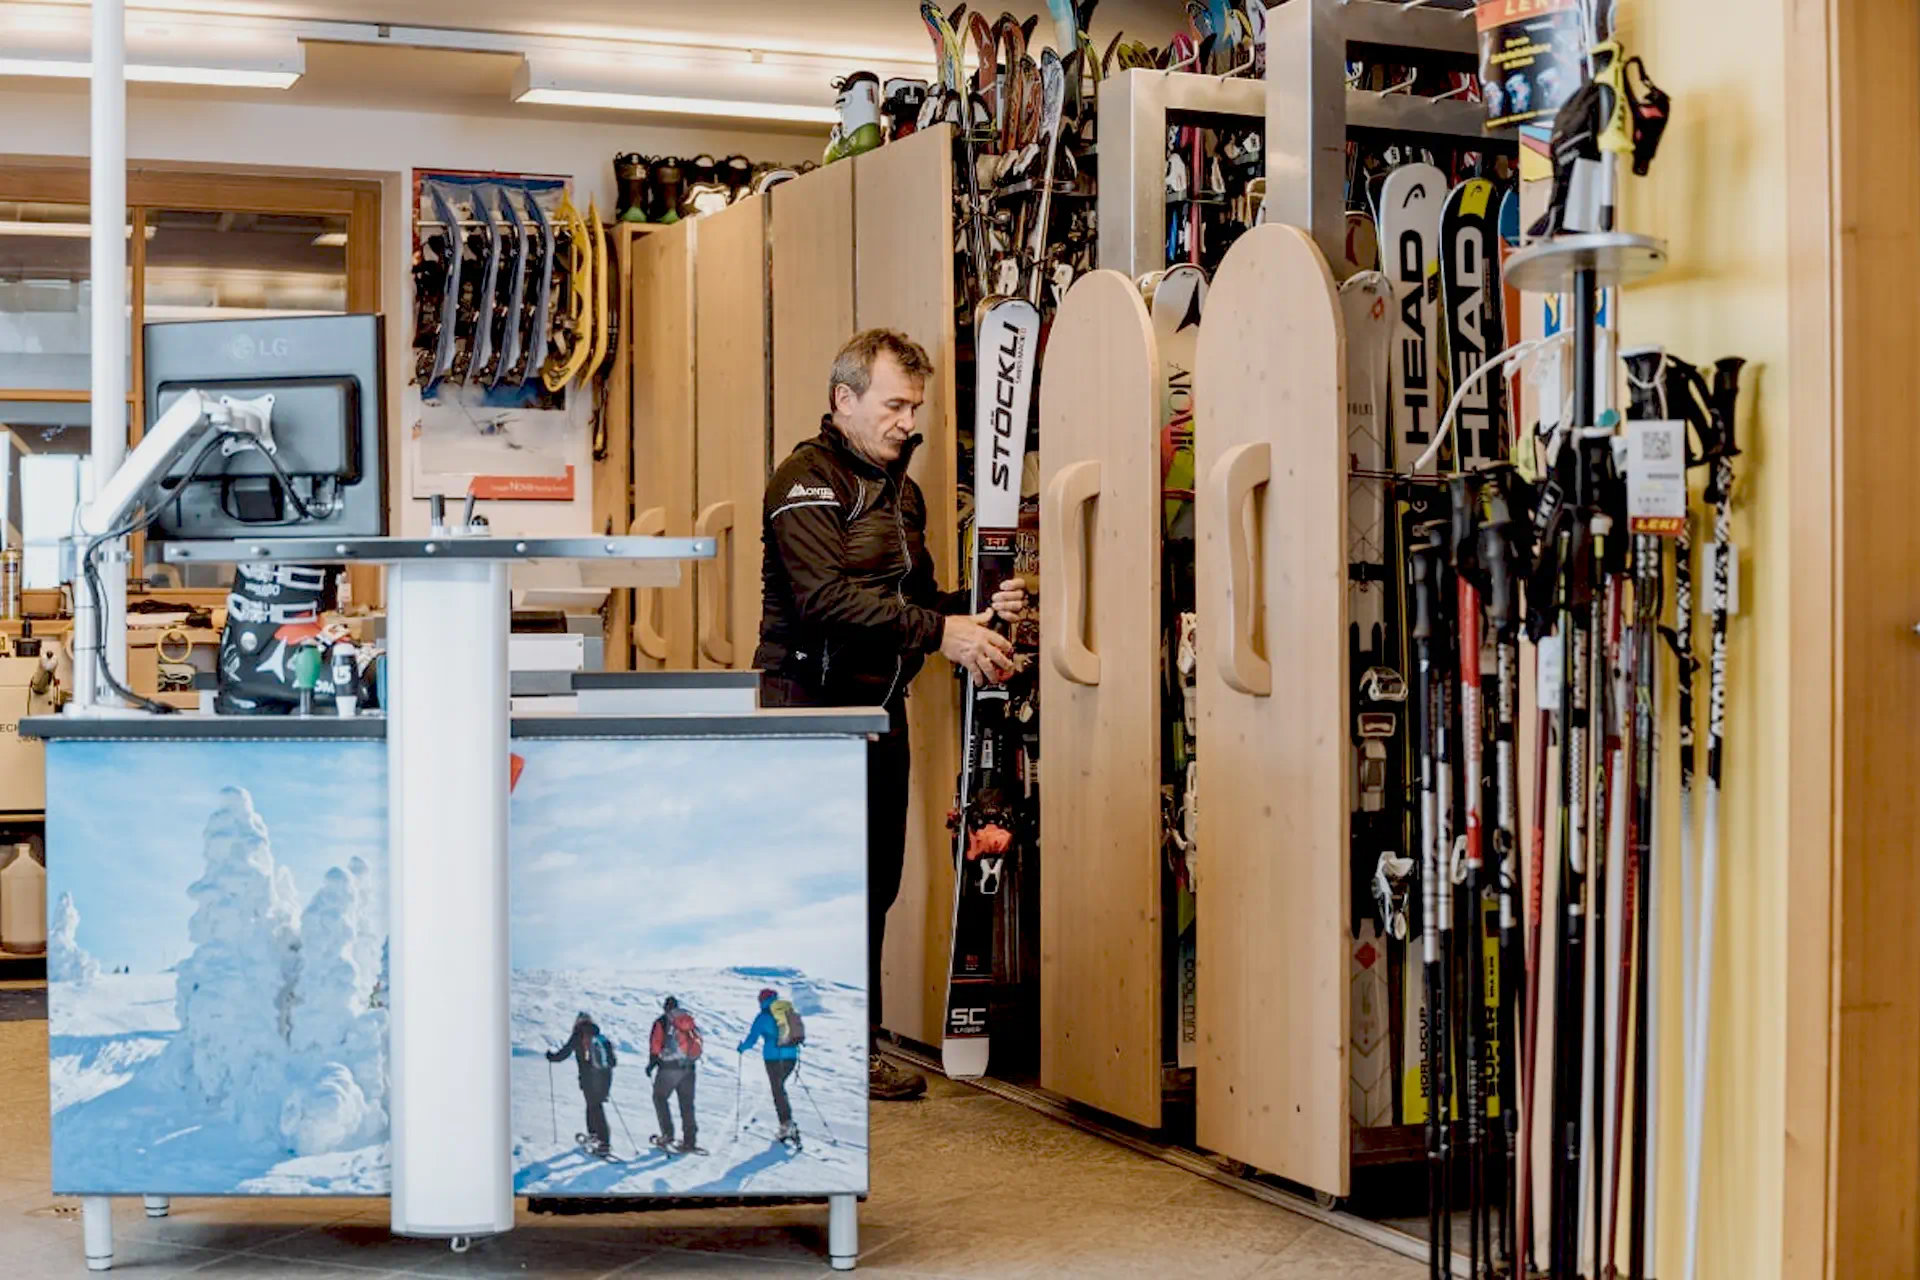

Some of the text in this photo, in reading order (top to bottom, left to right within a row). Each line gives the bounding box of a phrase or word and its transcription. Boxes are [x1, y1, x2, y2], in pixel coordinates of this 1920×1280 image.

[260, 338, 288, 356] LG
[1400, 230, 1429, 444] HEAD
[1455, 225, 1491, 471] HEAD
[990, 321, 1020, 492] STÖCKLI
[1636, 518, 1679, 530] LEKI
[951, 1008, 987, 1025] SC
